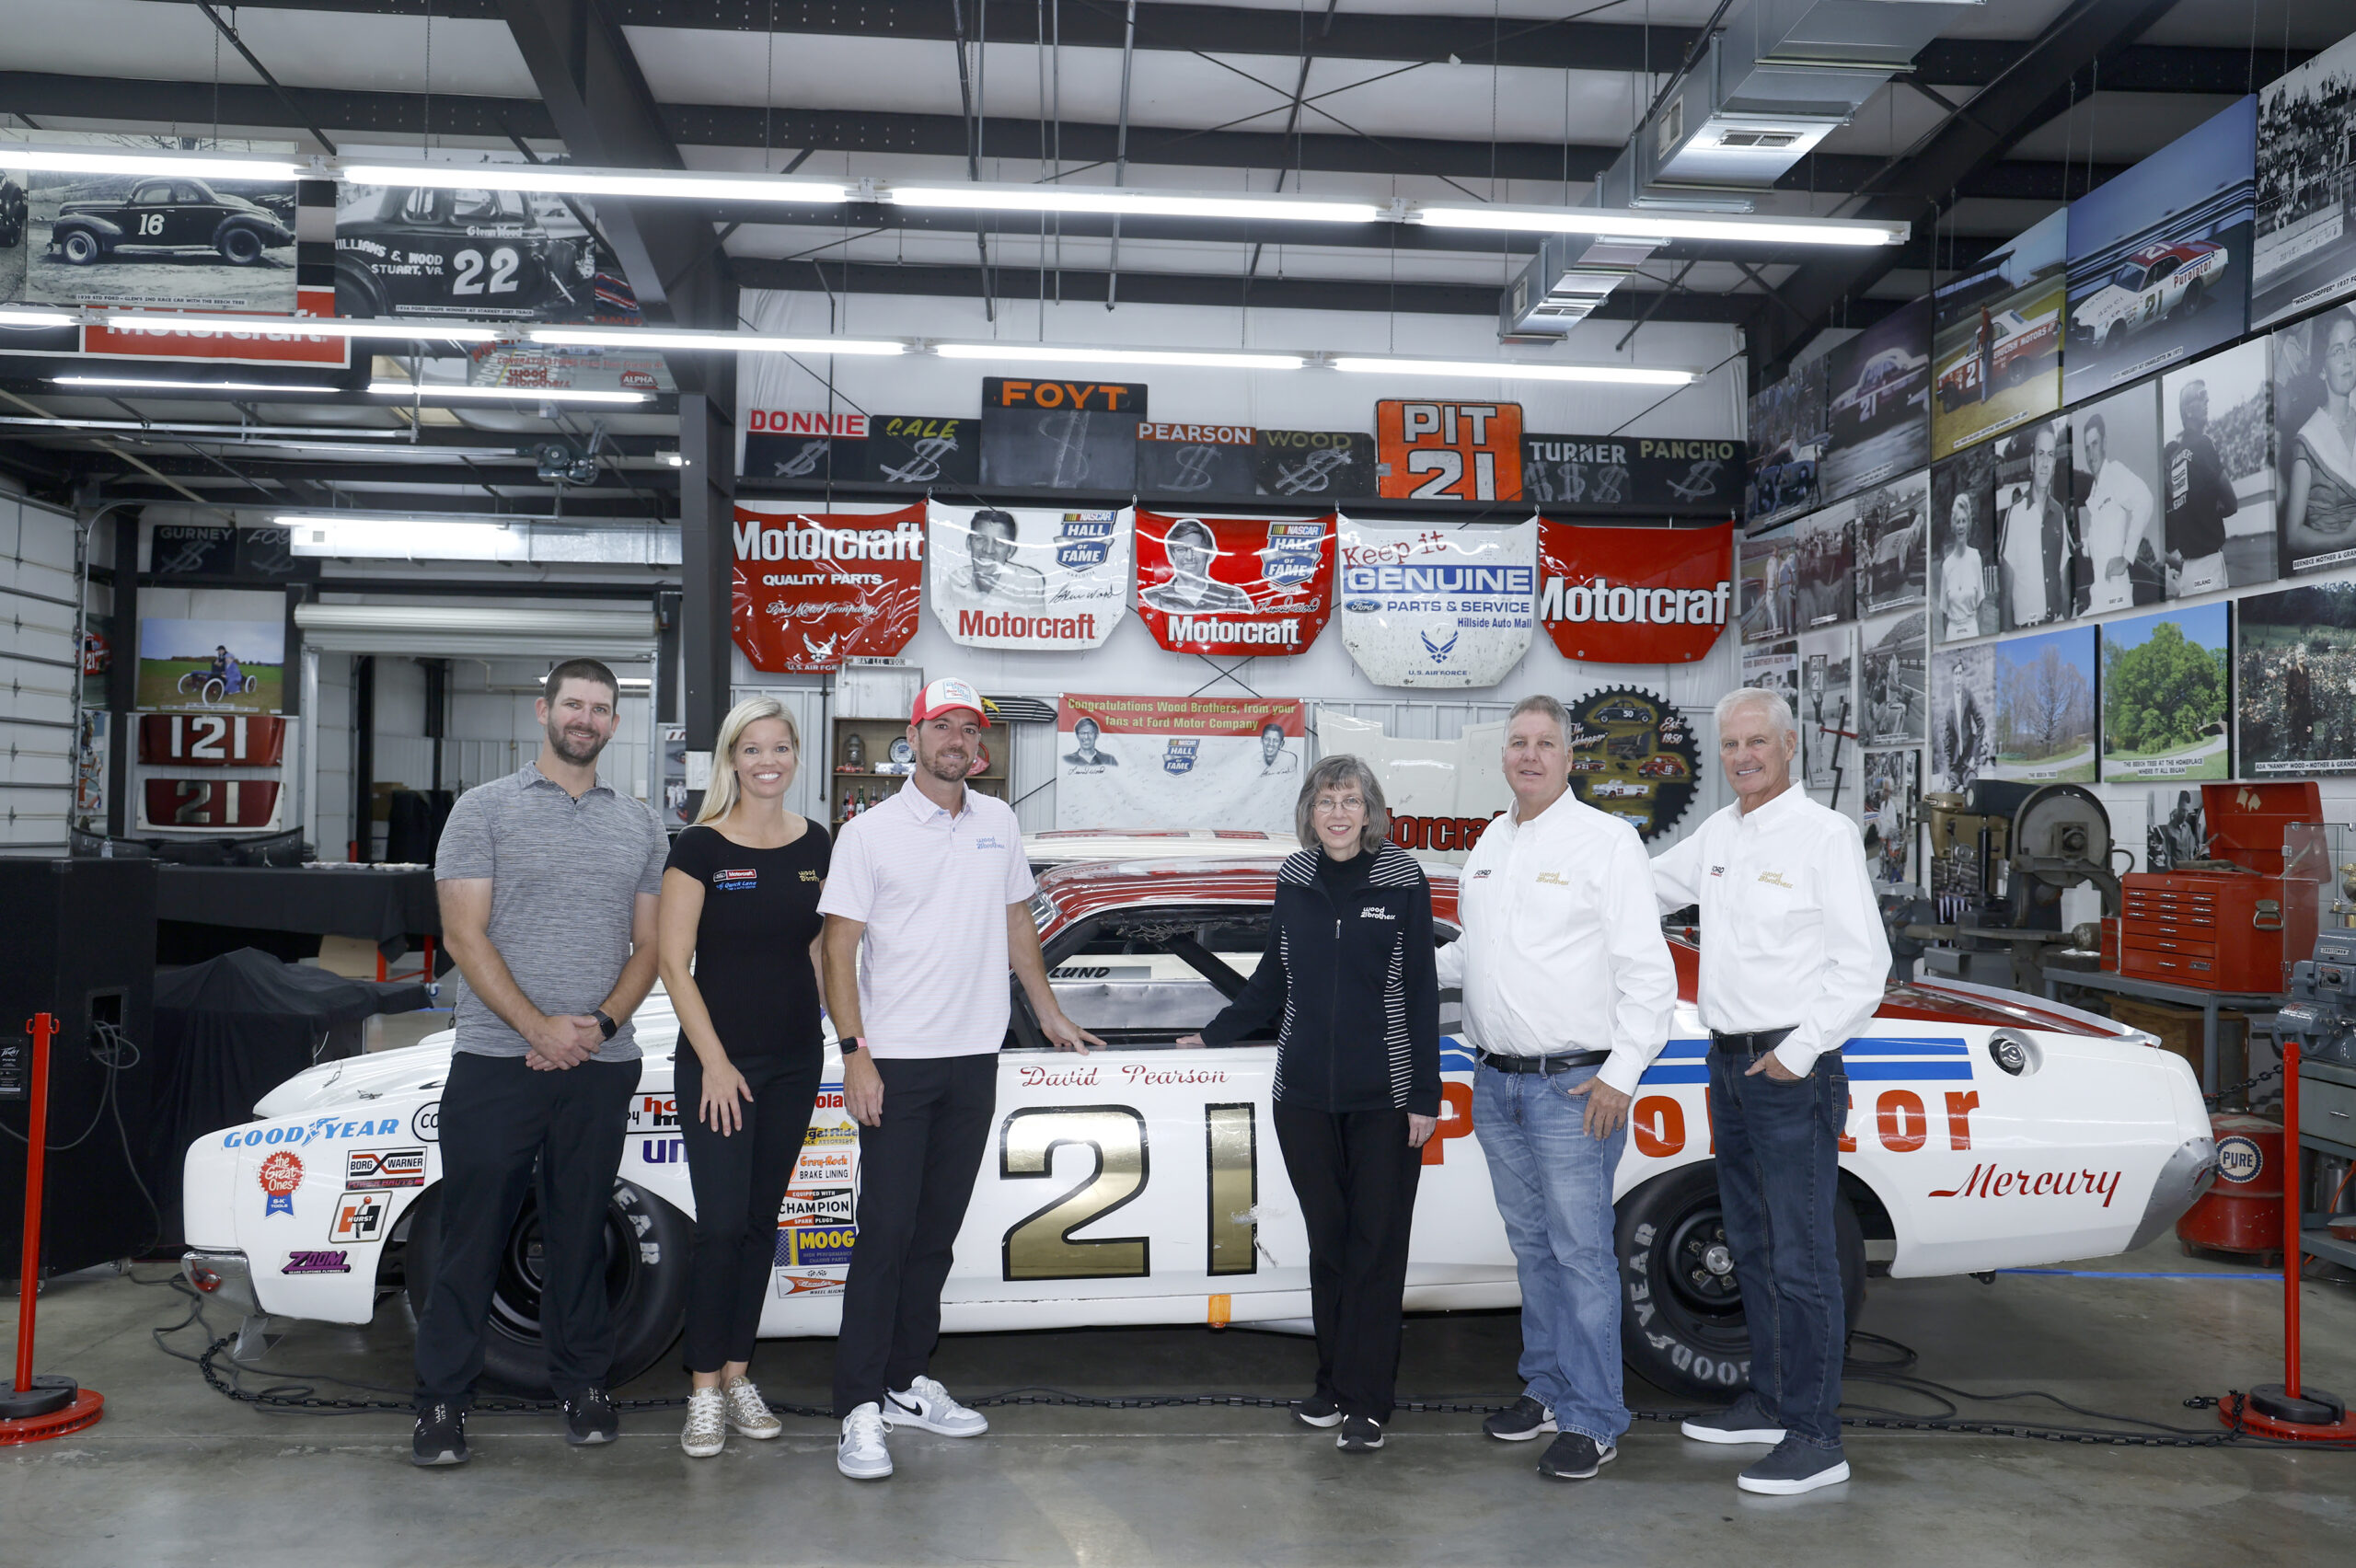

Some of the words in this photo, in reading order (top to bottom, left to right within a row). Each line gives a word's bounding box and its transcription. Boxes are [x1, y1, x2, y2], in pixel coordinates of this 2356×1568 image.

[138, 213, 165, 236] 16
[335, 239, 387, 257] ILLIAMS
[391, 251, 401, 262] &
[409, 253, 444, 266] WOOD
[453, 248, 520, 295] 22
[2174, 259, 2212, 289] Purolator
[2144, 289, 2164, 322] 21
[2020, 327, 2047, 346] MOTORS
[623, 375, 653, 384] ALPHA
[1002, 380, 1128, 410] FOYT
[1859, 392, 1877, 422] 21
[750, 409, 864, 435] DONNIE
[886, 418, 959, 437] CALE
[1403, 403, 1498, 445] PIT
[1138, 422, 1252, 444] PEARSON
[1266, 431, 1352, 449] WOOD
[1528, 441, 1626, 465] TURNER
[1640, 440, 1734, 460] PANCHO
[1407, 448, 1497, 501] 21
[1080, 512, 1112, 522] NASCAR
[160, 527, 233, 541] GURNEY
[1067, 525, 1105, 536] HALL
[1288, 525, 1319, 535] NASCAR
[733, 521, 924, 561] Motorcraft
[1275, 537, 1312, 550] HALL
[1061, 550, 1102, 562] FAME
[1341, 541, 1410, 570] Keep
[1418, 531, 1448, 554] it
[2316, 555, 2336, 563] MOTHER
[762, 573, 826, 586] QUALITY
[830, 573, 884, 585] PARTS
[1268, 564, 1308, 577] FAME
[1347, 567, 1530, 592] GENUINE
[1351, 601, 1376, 611] Ford
[1387, 601, 1441, 612] PARTS
[1447, 601, 1458, 612] &
[1461, 601, 1530, 613] SERVICE
[958, 609, 1095, 640] Motorcraft
[1168, 615, 1299, 644] Motorcraft
[1458, 617, 1489, 628] Hillside
[1492, 618, 1512, 628] Auto
[1514, 618, 1532, 628] Mall
[1811, 656, 1825, 669] PIT
[1811, 671, 1824, 690] 21
[1068, 698, 1153, 712] Congratulations
[1157, 702, 1187, 712] Wood
[1191, 702, 1240, 715] Brothers,
[1243, 704, 1269, 714] from
[1272, 705, 1296, 716] your
[1623, 709, 1634, 718] 50
[1105, 716, 1128, 727] fans
[1132, 717, 1144, 727] at
[1147, 717, 1170, 728] Ford
[1173, 718, 1206, 729] Motor
[1209, 718, 1259, 731] Company
[170, 715, 248, 759] 121
[1661, 732, 1683, 744] 1950
[1167, 762, 1189, 770] FAME
[1665, 765, 1673, 773] 16
[2176, 757, 2203, 766] HOMEPLACE
[175, 780, 240, 824] 21
[1020, 1066, 1101, 1087] David
[1121, 1064, 1231, 1086] Pearson
[275, 1154, 290, 1167] the
[351, 1160, 373, 1170] BORG
[387, 1158, 423, 1168] WARNER
[2223, 1151, 2253, 1168] PURE
[264, 1167, 297, 1180] Great
[800, 1170, 823, 1180] BRAKE
[826, 1170, 849, 1179] LINING
[268, 1180, 294, 1192] Ones
[999, 1101, 1258, 1282] 21
[1928, 1162, 2121, 1208] Mercury
[779, 1200, 849, 1215] CHAMPION
[347, 1215, 374, 1223] HURST
[799, 1229, 856, 1250] MOOG
[282, 1251, 352, 1272] ZOOM
